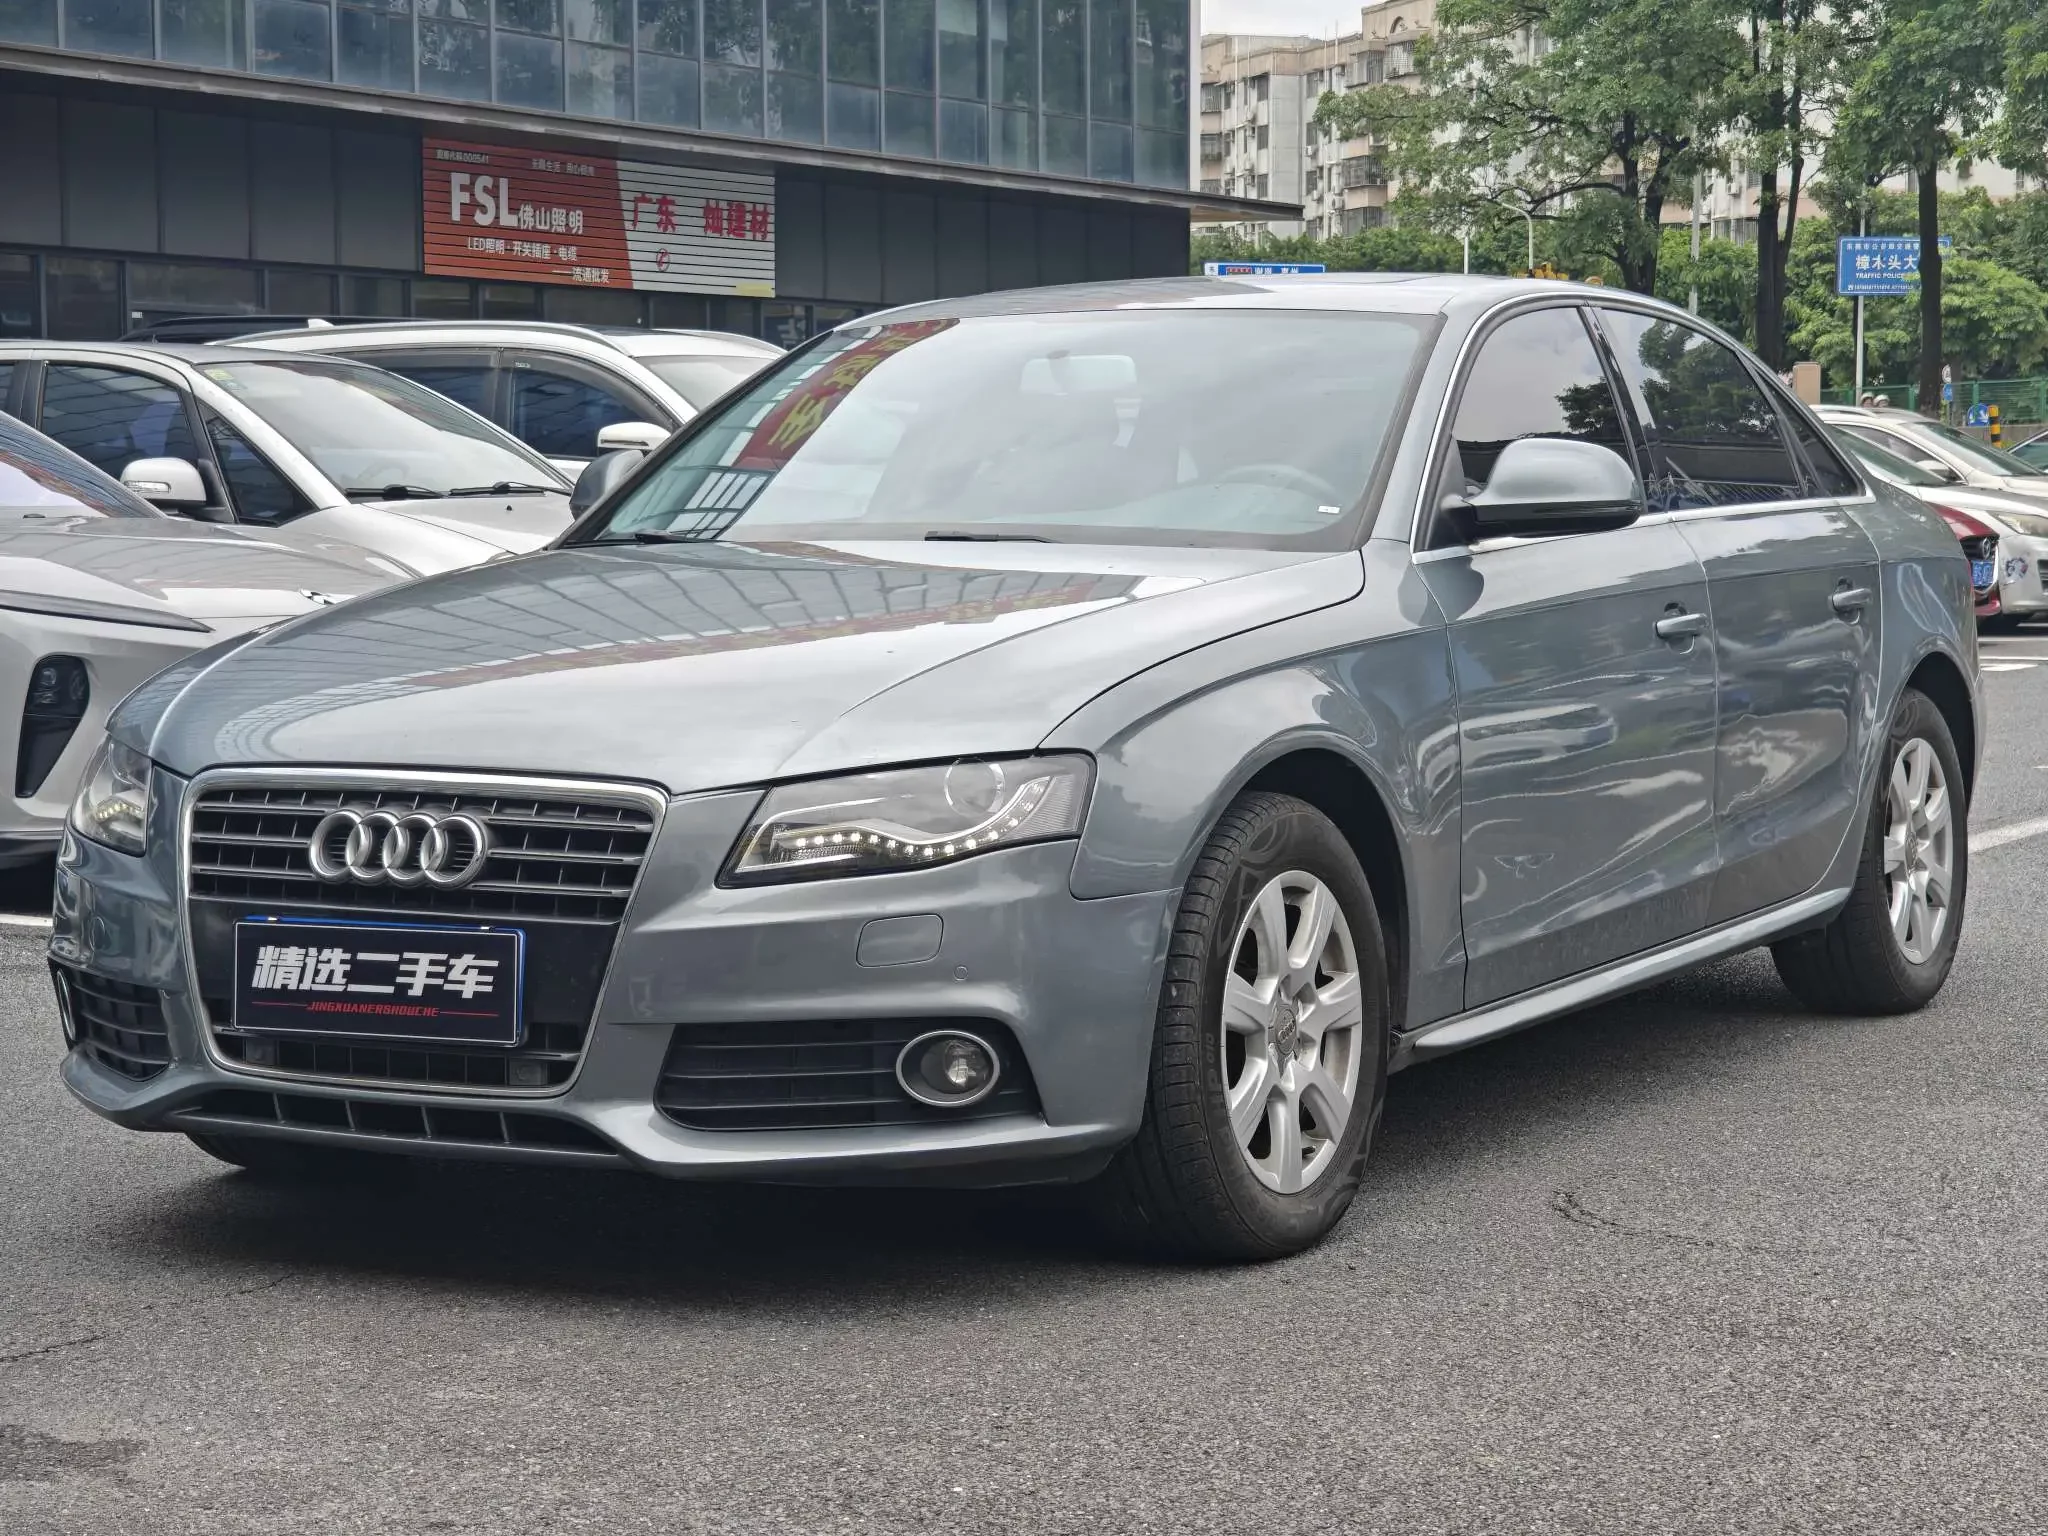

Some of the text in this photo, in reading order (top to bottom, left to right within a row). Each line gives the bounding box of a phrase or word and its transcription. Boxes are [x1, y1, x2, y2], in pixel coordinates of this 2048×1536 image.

[450, 172, 518, 227] FSL
[518, 203, 584, 235] 佛山照明
[632, 192, 677, 233] 广东
[251, 945, 500, 999] 精选二手车
